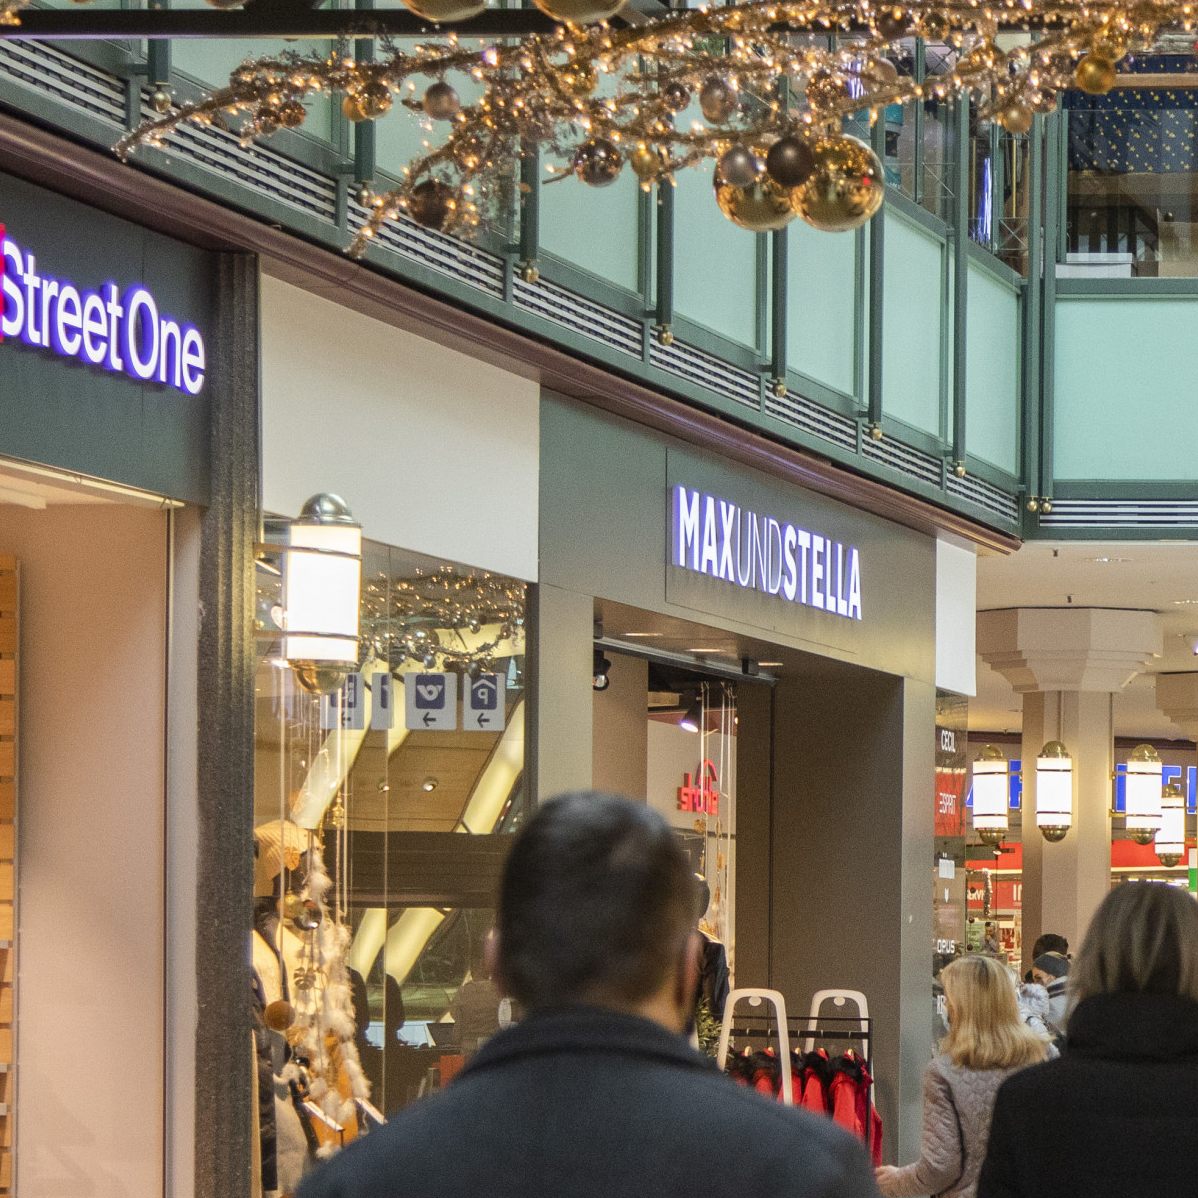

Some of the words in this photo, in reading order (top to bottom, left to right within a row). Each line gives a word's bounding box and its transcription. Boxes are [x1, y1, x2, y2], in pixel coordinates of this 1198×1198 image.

[2, 239, 124, 371] Street
[128, 289, 206, 395] One
[941, 730, 956, 753] CECIL
[937, 939, 955, 954] OPUS
